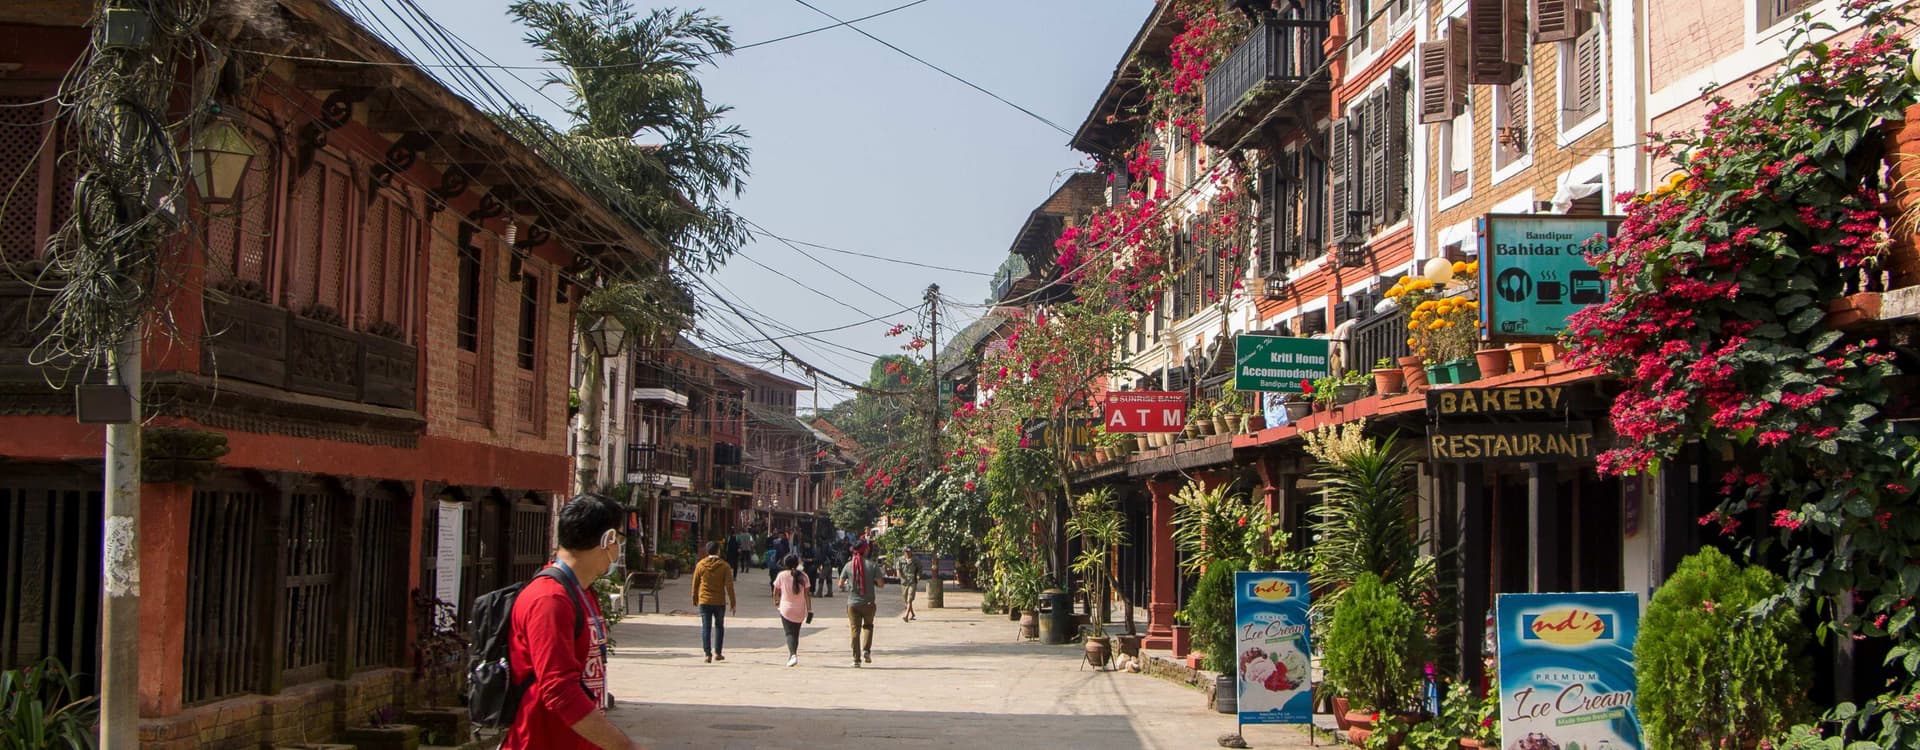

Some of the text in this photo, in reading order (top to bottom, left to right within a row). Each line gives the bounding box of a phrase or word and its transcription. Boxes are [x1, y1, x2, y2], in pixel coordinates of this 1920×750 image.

[1526, 231, 1573, 241] Bandipur
[1496, 243, 1561, 256] Bahidar
[1270, 352, 1325, 365] Kriti Home
[1242, 365, 1326, 379] Accommodation
[1260, 380, 1288, 389] Bandipur
[1120, 395, 1182, 403] SUNRISE BANK
[1440, 387, 1562, 414] BAKERY
[1110, 409, 1181, 426] ATM
[1432, 432, 1593, 459] RESTAURANT
[1254, 581, 1291, 593] nd's
[1531, 609, 1606, 632] nd's
[1241, 622, 1264, 642] Ice
[1265, 620, 1305, 637] Cream
[1508, 683, 1632, 722] Ice Cream
